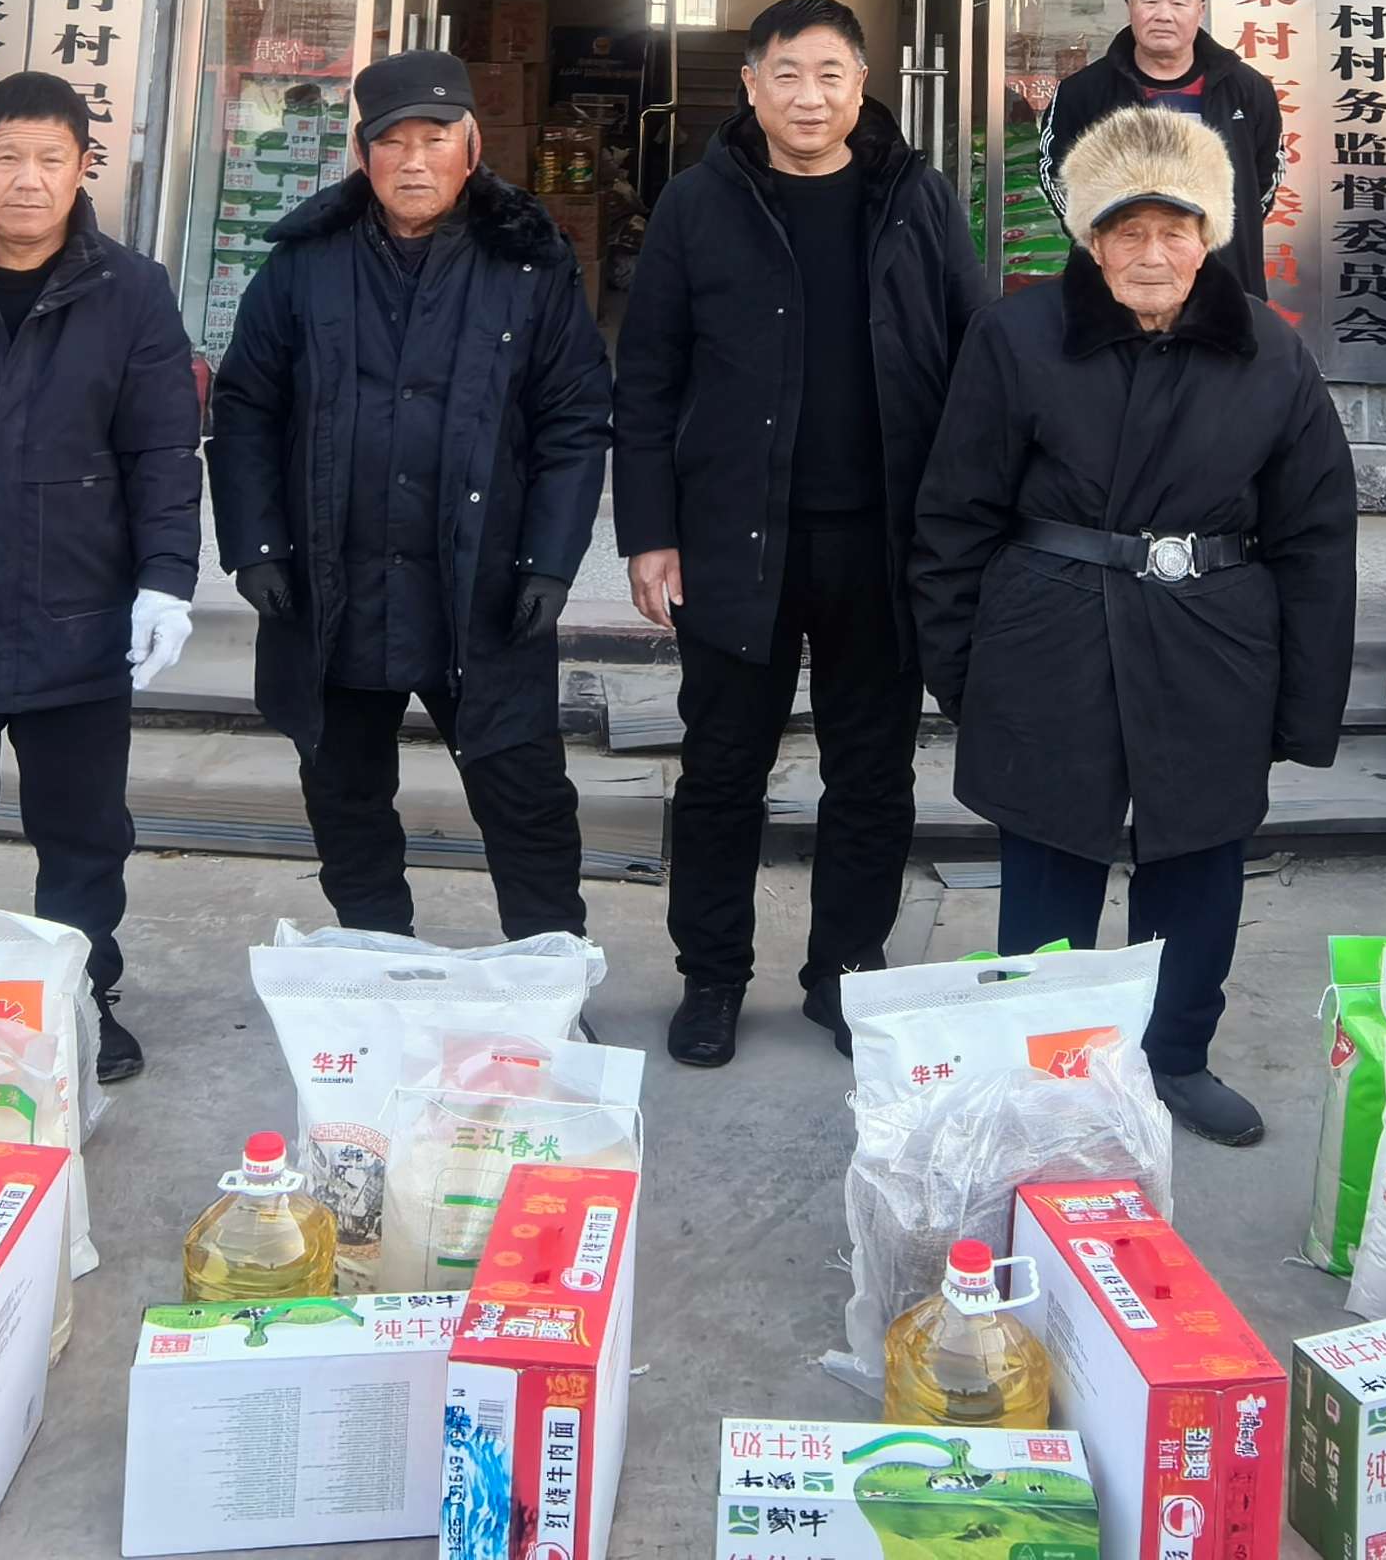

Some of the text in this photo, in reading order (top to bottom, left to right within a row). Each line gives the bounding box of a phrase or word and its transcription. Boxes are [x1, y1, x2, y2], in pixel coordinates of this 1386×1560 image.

[313, 1052, 358, 1075] 华升
[911, 1062, 954, 1085] 华升
[451, 1126, 563, 1161] 三江香米
[730, 1430, 832, 1461] 纯牛奶
[543, 1419, 577, 1528] 红烧牛肉面
[767, 1507, 827, 1537] 蒙牛
